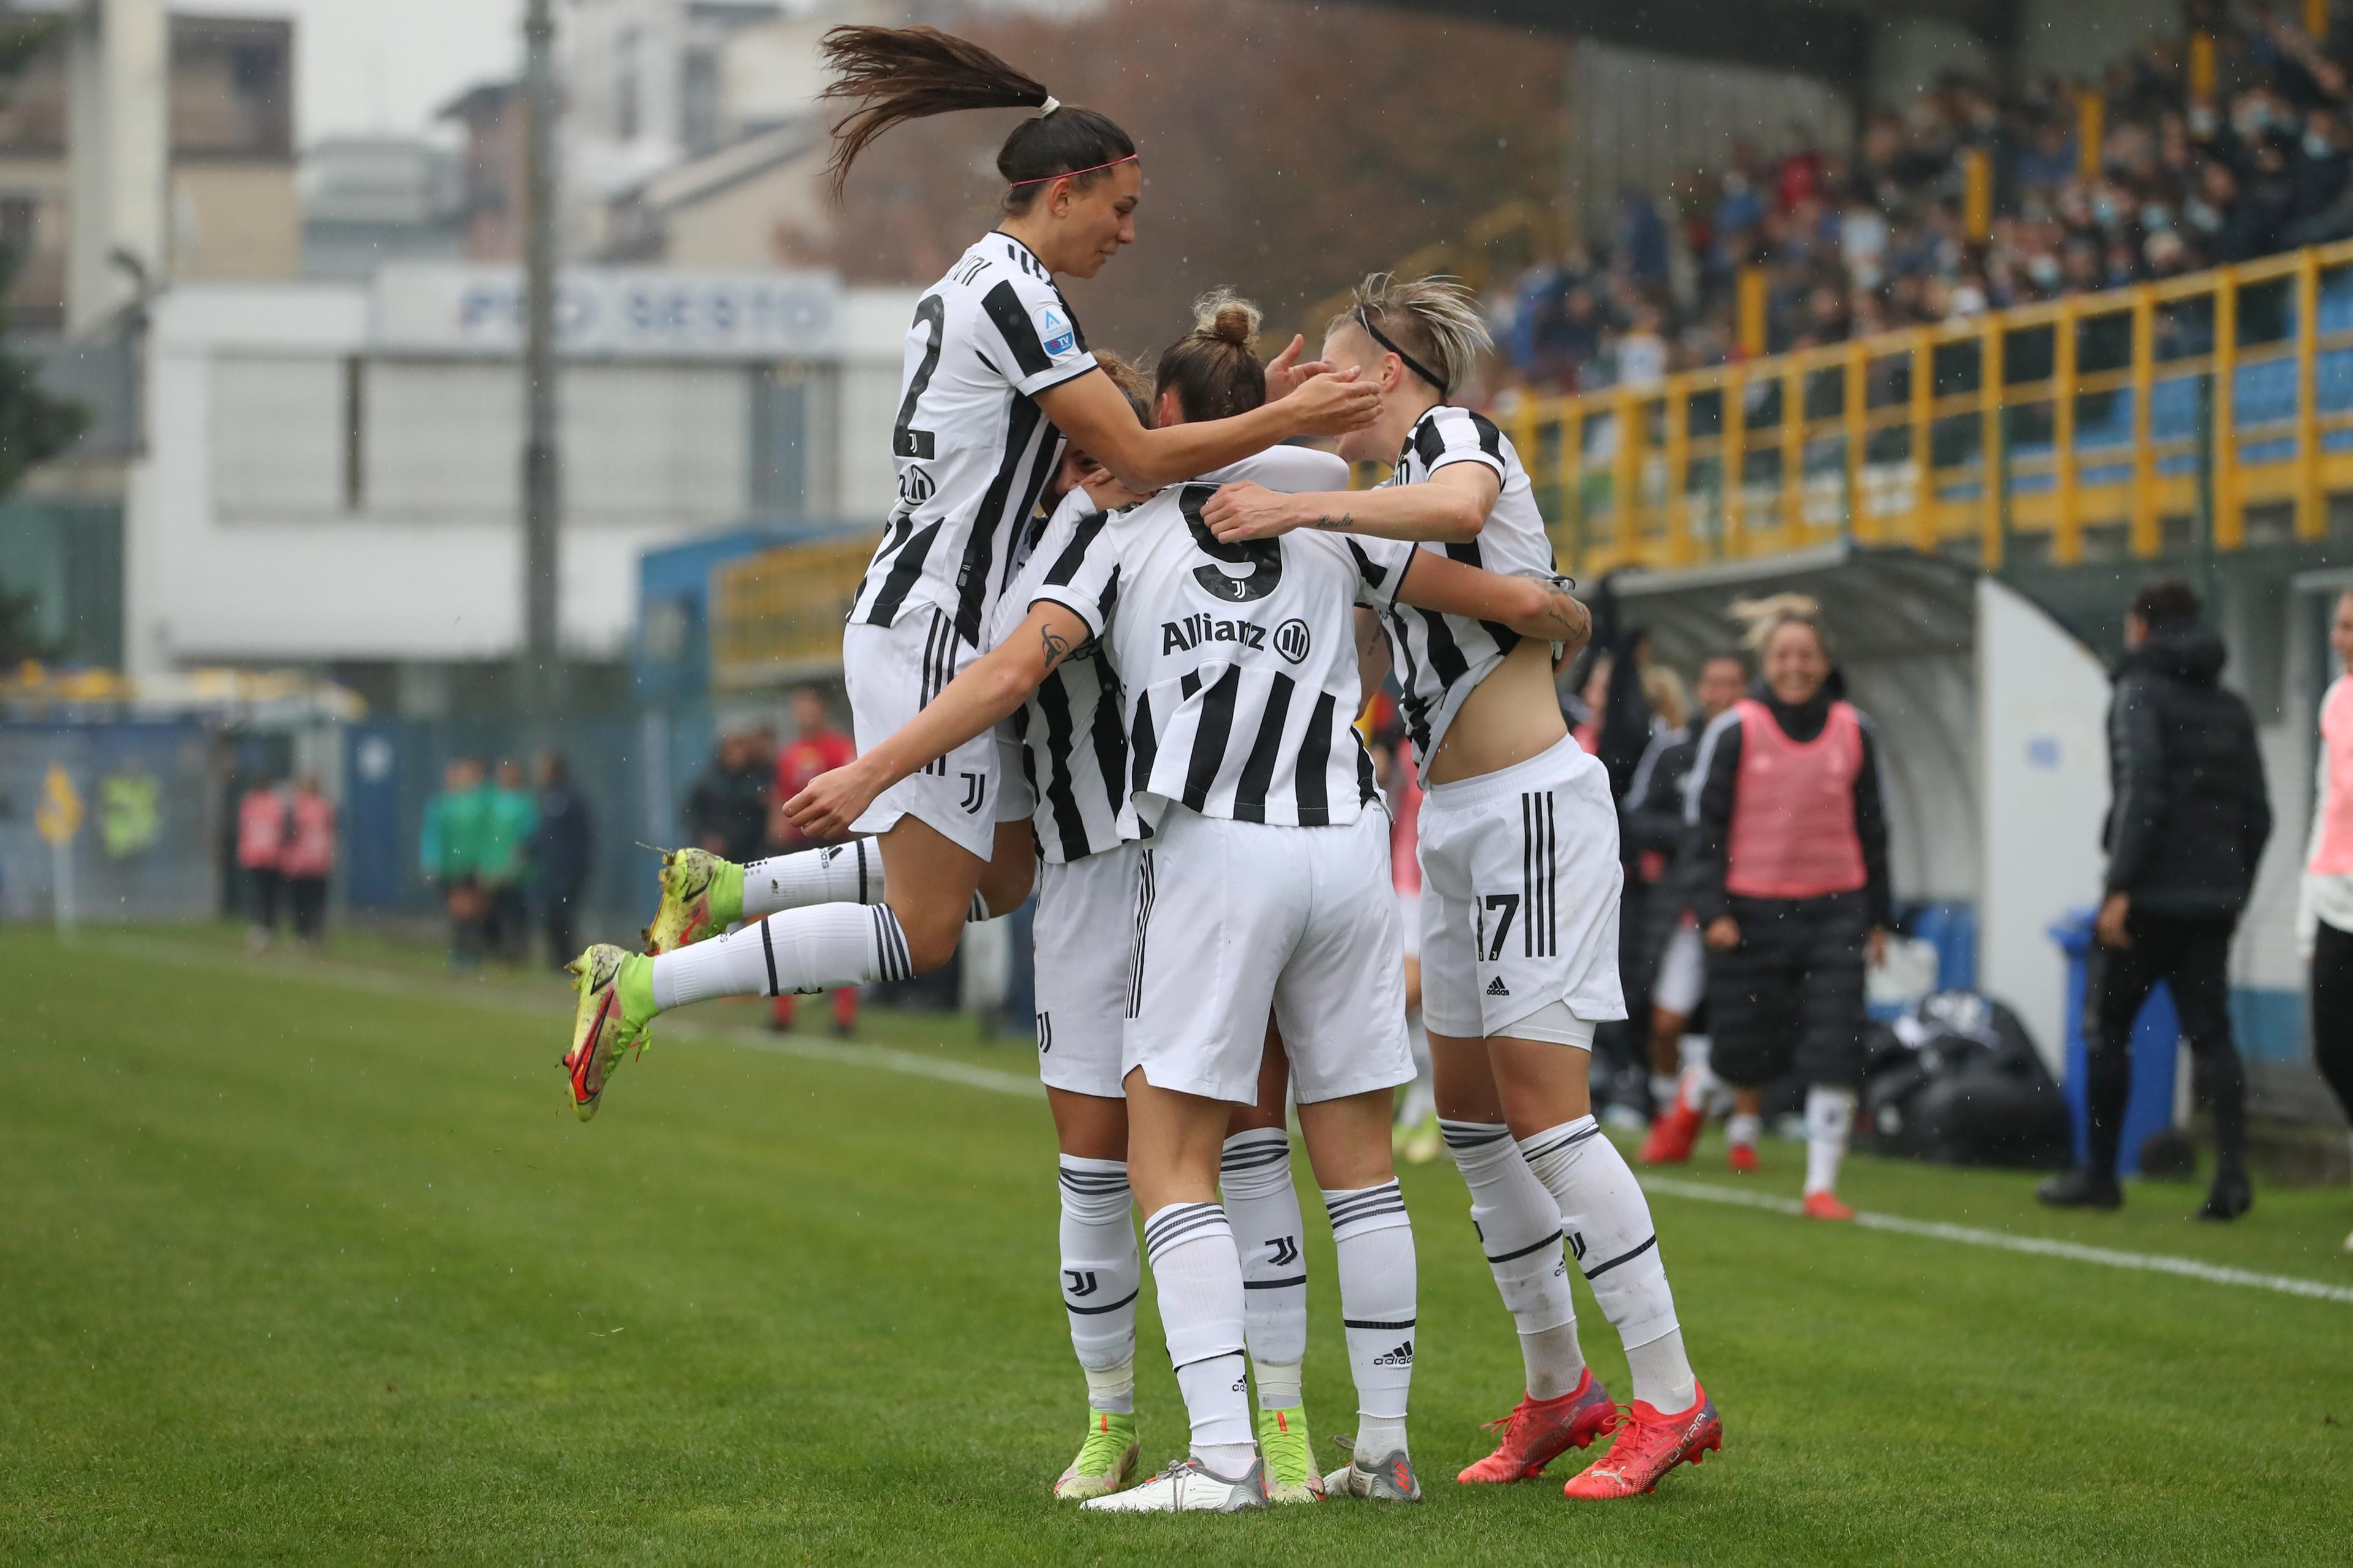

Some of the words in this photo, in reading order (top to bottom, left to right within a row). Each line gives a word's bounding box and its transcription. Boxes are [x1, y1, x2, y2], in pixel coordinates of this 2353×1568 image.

[460, 279, 601, 335] PO
[1058, 336, 1069, 346] TV
[1161, 613, 1267, 656] Allianz
[1487, 987, 1510, 996] adidas
[1373, 1354, 1414, 1365] adida
